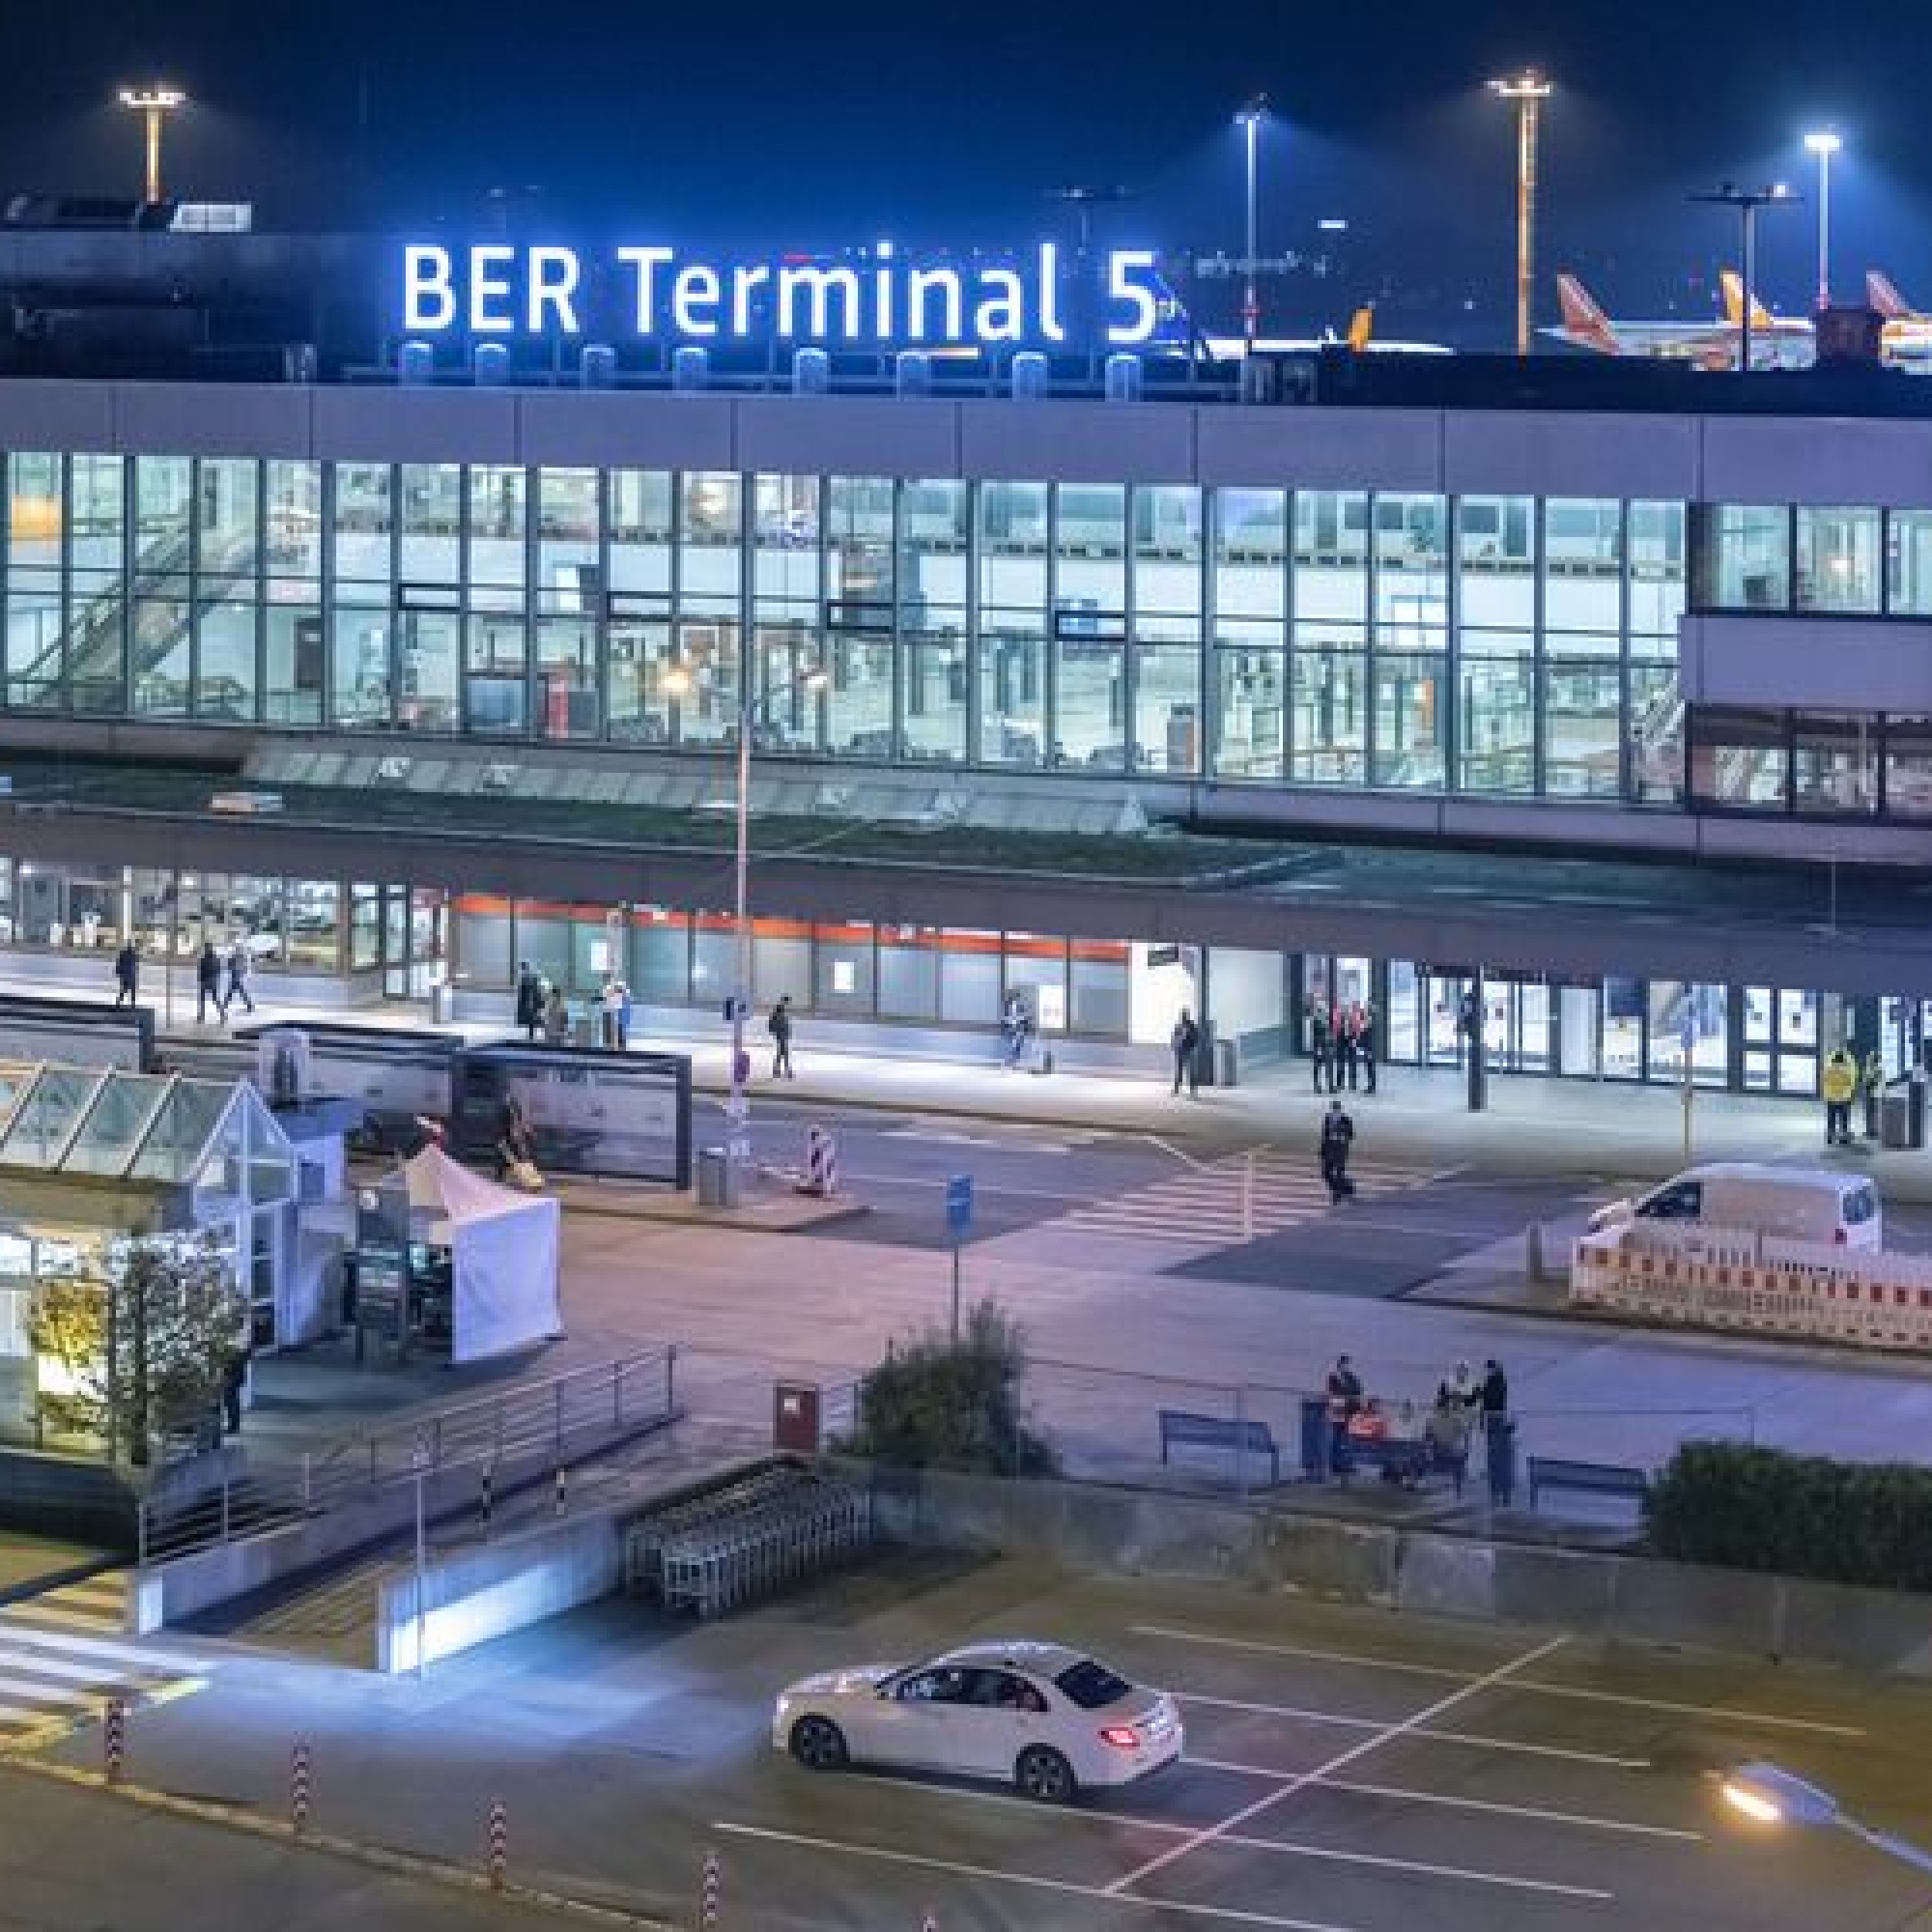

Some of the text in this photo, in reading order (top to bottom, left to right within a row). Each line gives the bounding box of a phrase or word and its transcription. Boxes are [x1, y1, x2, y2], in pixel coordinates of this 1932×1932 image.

[404, 242, 1156, 344] BER Terminal 5
